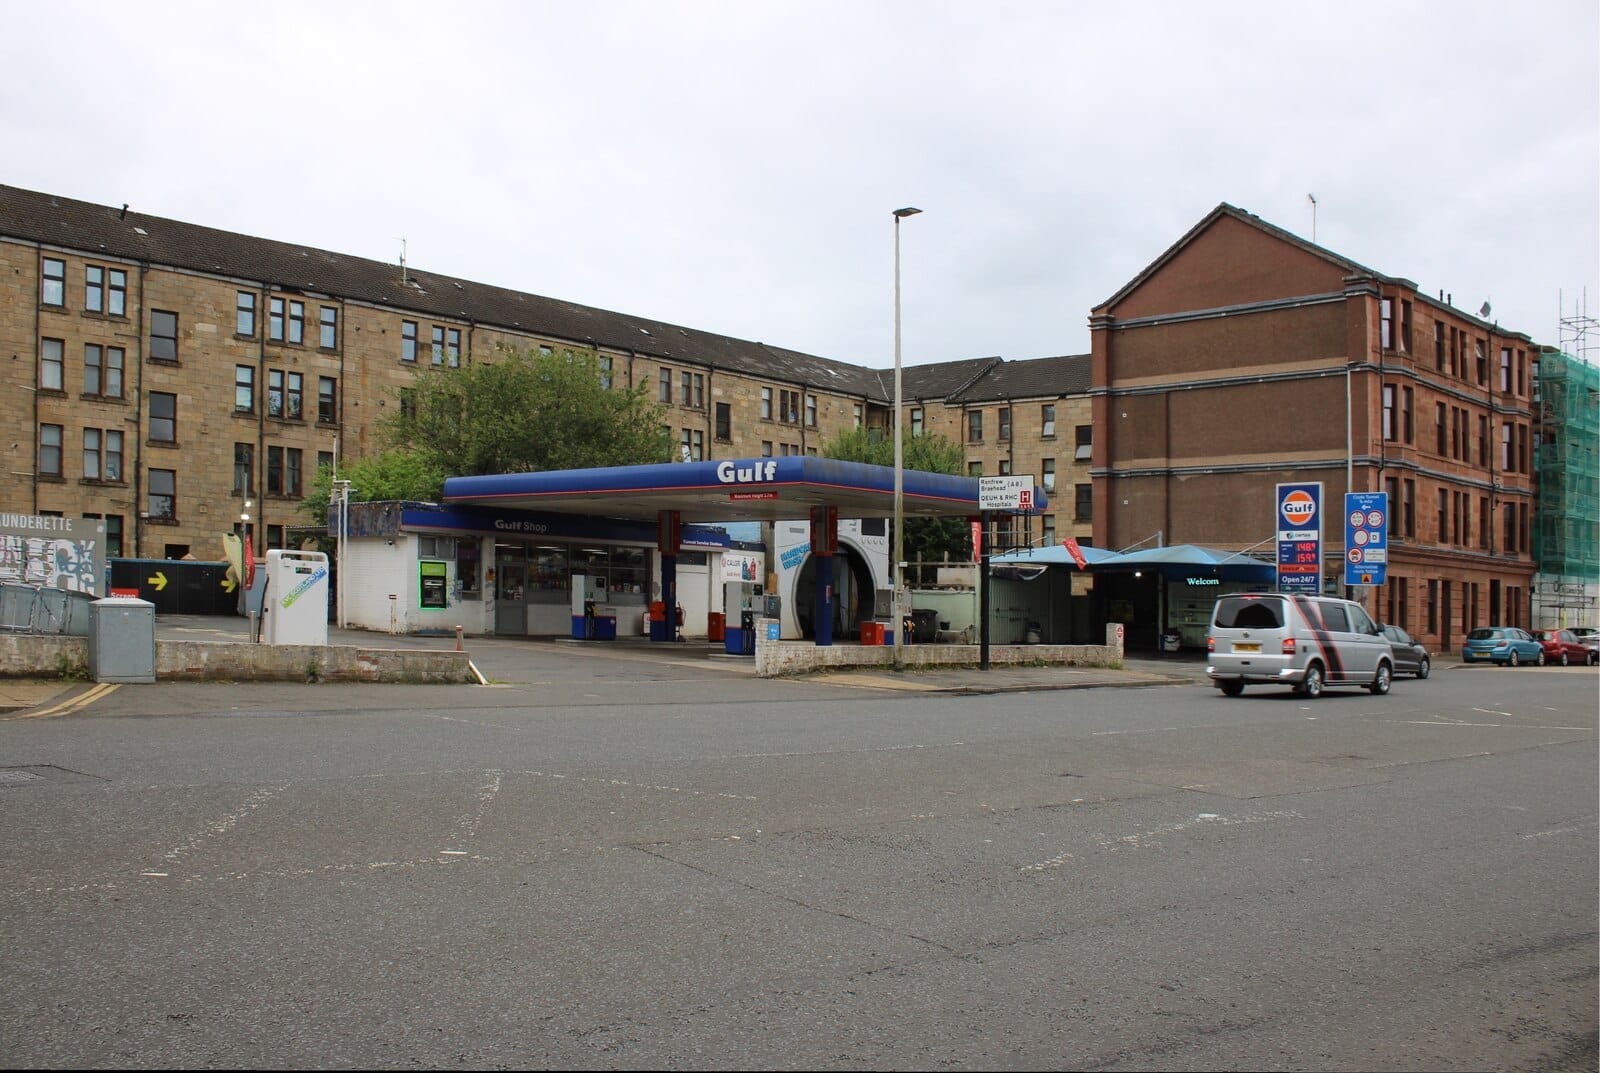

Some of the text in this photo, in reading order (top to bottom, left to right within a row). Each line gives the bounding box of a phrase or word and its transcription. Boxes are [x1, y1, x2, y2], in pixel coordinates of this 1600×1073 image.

[717, 460, 777, 483] Gulf
[1284, 503, 1313, 513] Gulf
[0, 513, 73, 531] UNDERETTE
[495, 519, 547, 534] Gulf Shop
[1281, 576, 1300, 584] Open
